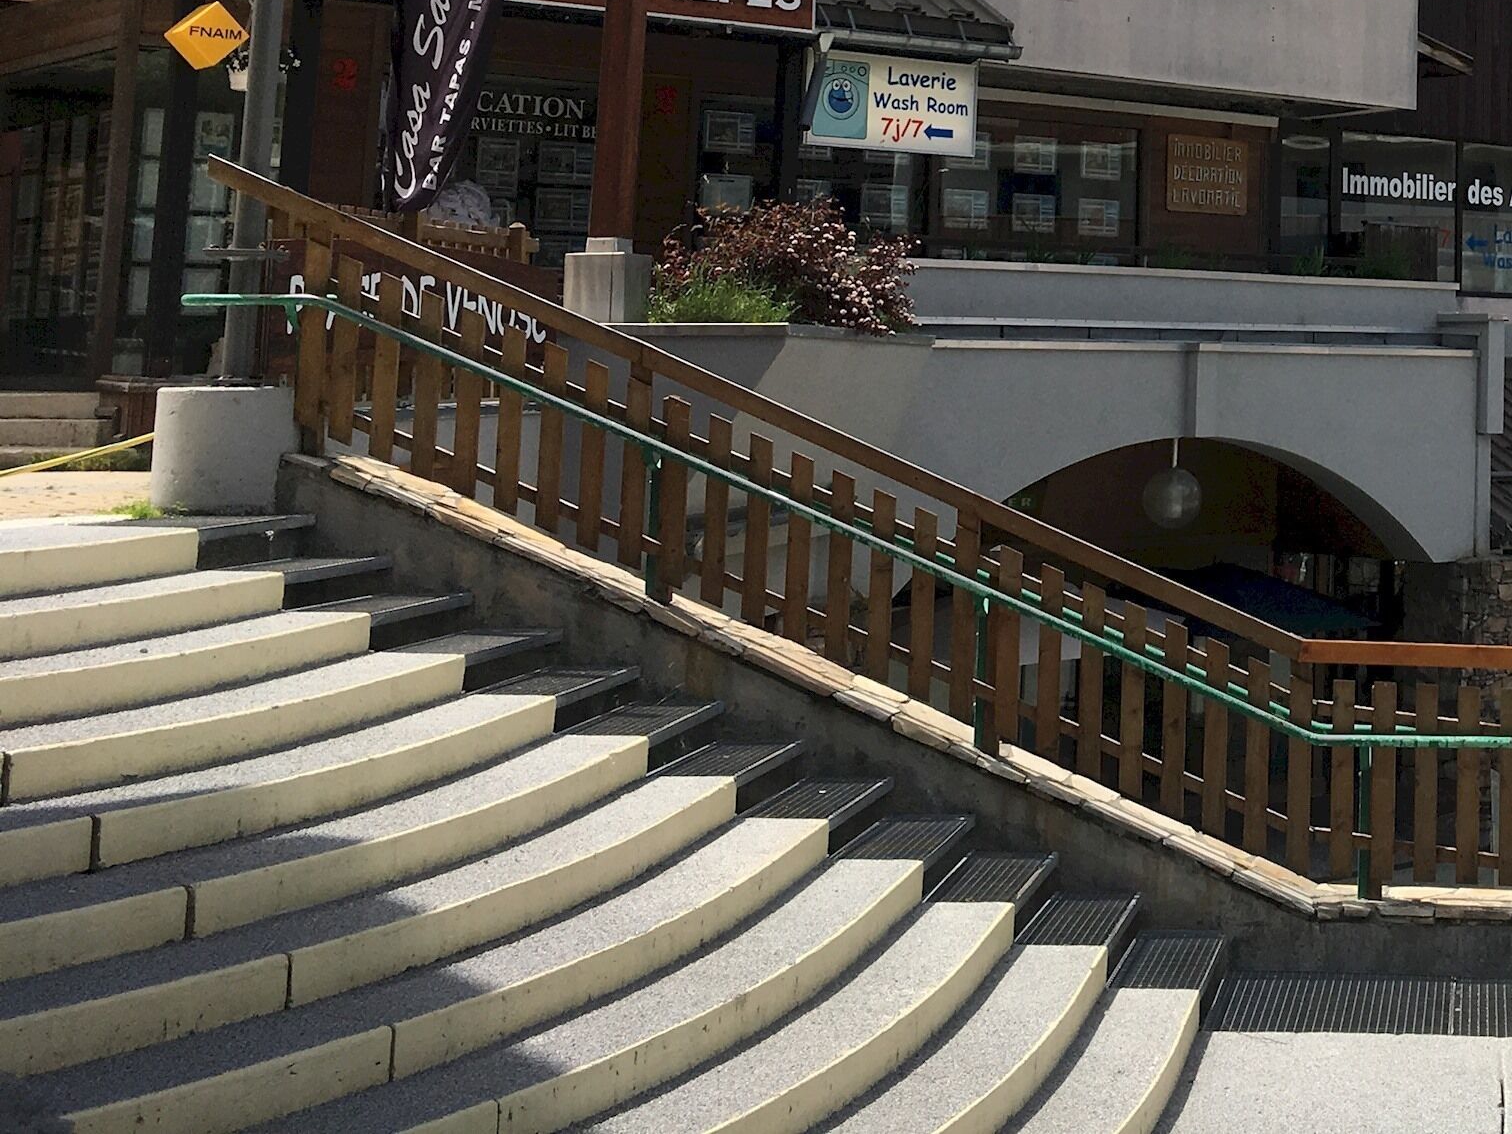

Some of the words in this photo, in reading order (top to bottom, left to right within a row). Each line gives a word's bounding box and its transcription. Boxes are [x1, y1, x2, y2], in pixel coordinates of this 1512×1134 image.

[189, 26, 243, 41] FNAIM
[887, 66, 957, 91] Laverie
[422, 134, 447, 191] BAR
[439, 38, 471, 125] TAPAS
[476, 90, 586, 120] CATION
[873, 92, 919, 112] Wash
[926, 97, 969, 117] Room
[470, 116, 544, 135] RVIETTES
[881, 117, 925, 142] 7j/7
[394, 82, 432, 200] Casa
[1342, 166, 1457, 202] Immobilier
[1467, 179, 1504, 206] des
